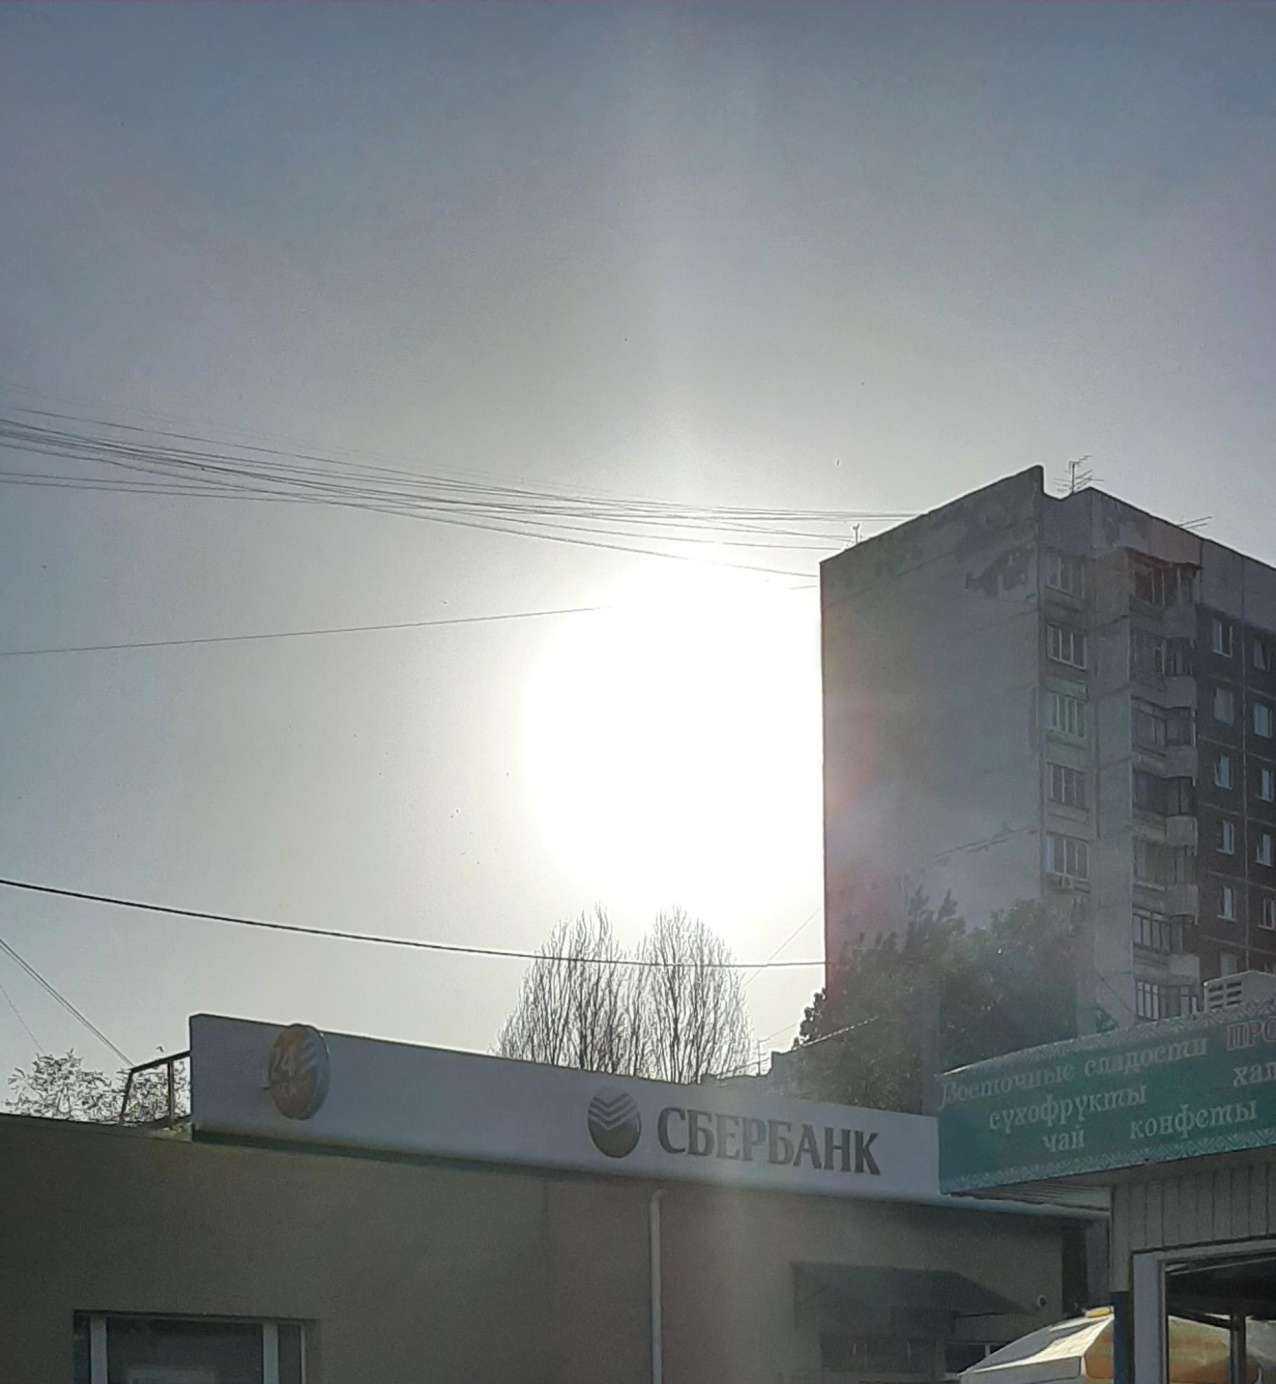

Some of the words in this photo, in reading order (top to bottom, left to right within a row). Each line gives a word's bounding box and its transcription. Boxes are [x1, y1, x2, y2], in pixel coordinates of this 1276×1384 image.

[937, 1061, 1074, 1111] Восточные
[1083, 1037, 1208, 1077] сладости
[988, 1084, 1149, 1136] сухофрукты
[1129, 1099, 1258, 1141] конфеты
[656, 1106, 882, 1175] СБЕРБАНК
[1042, 1125, 1086, 1153] чай
